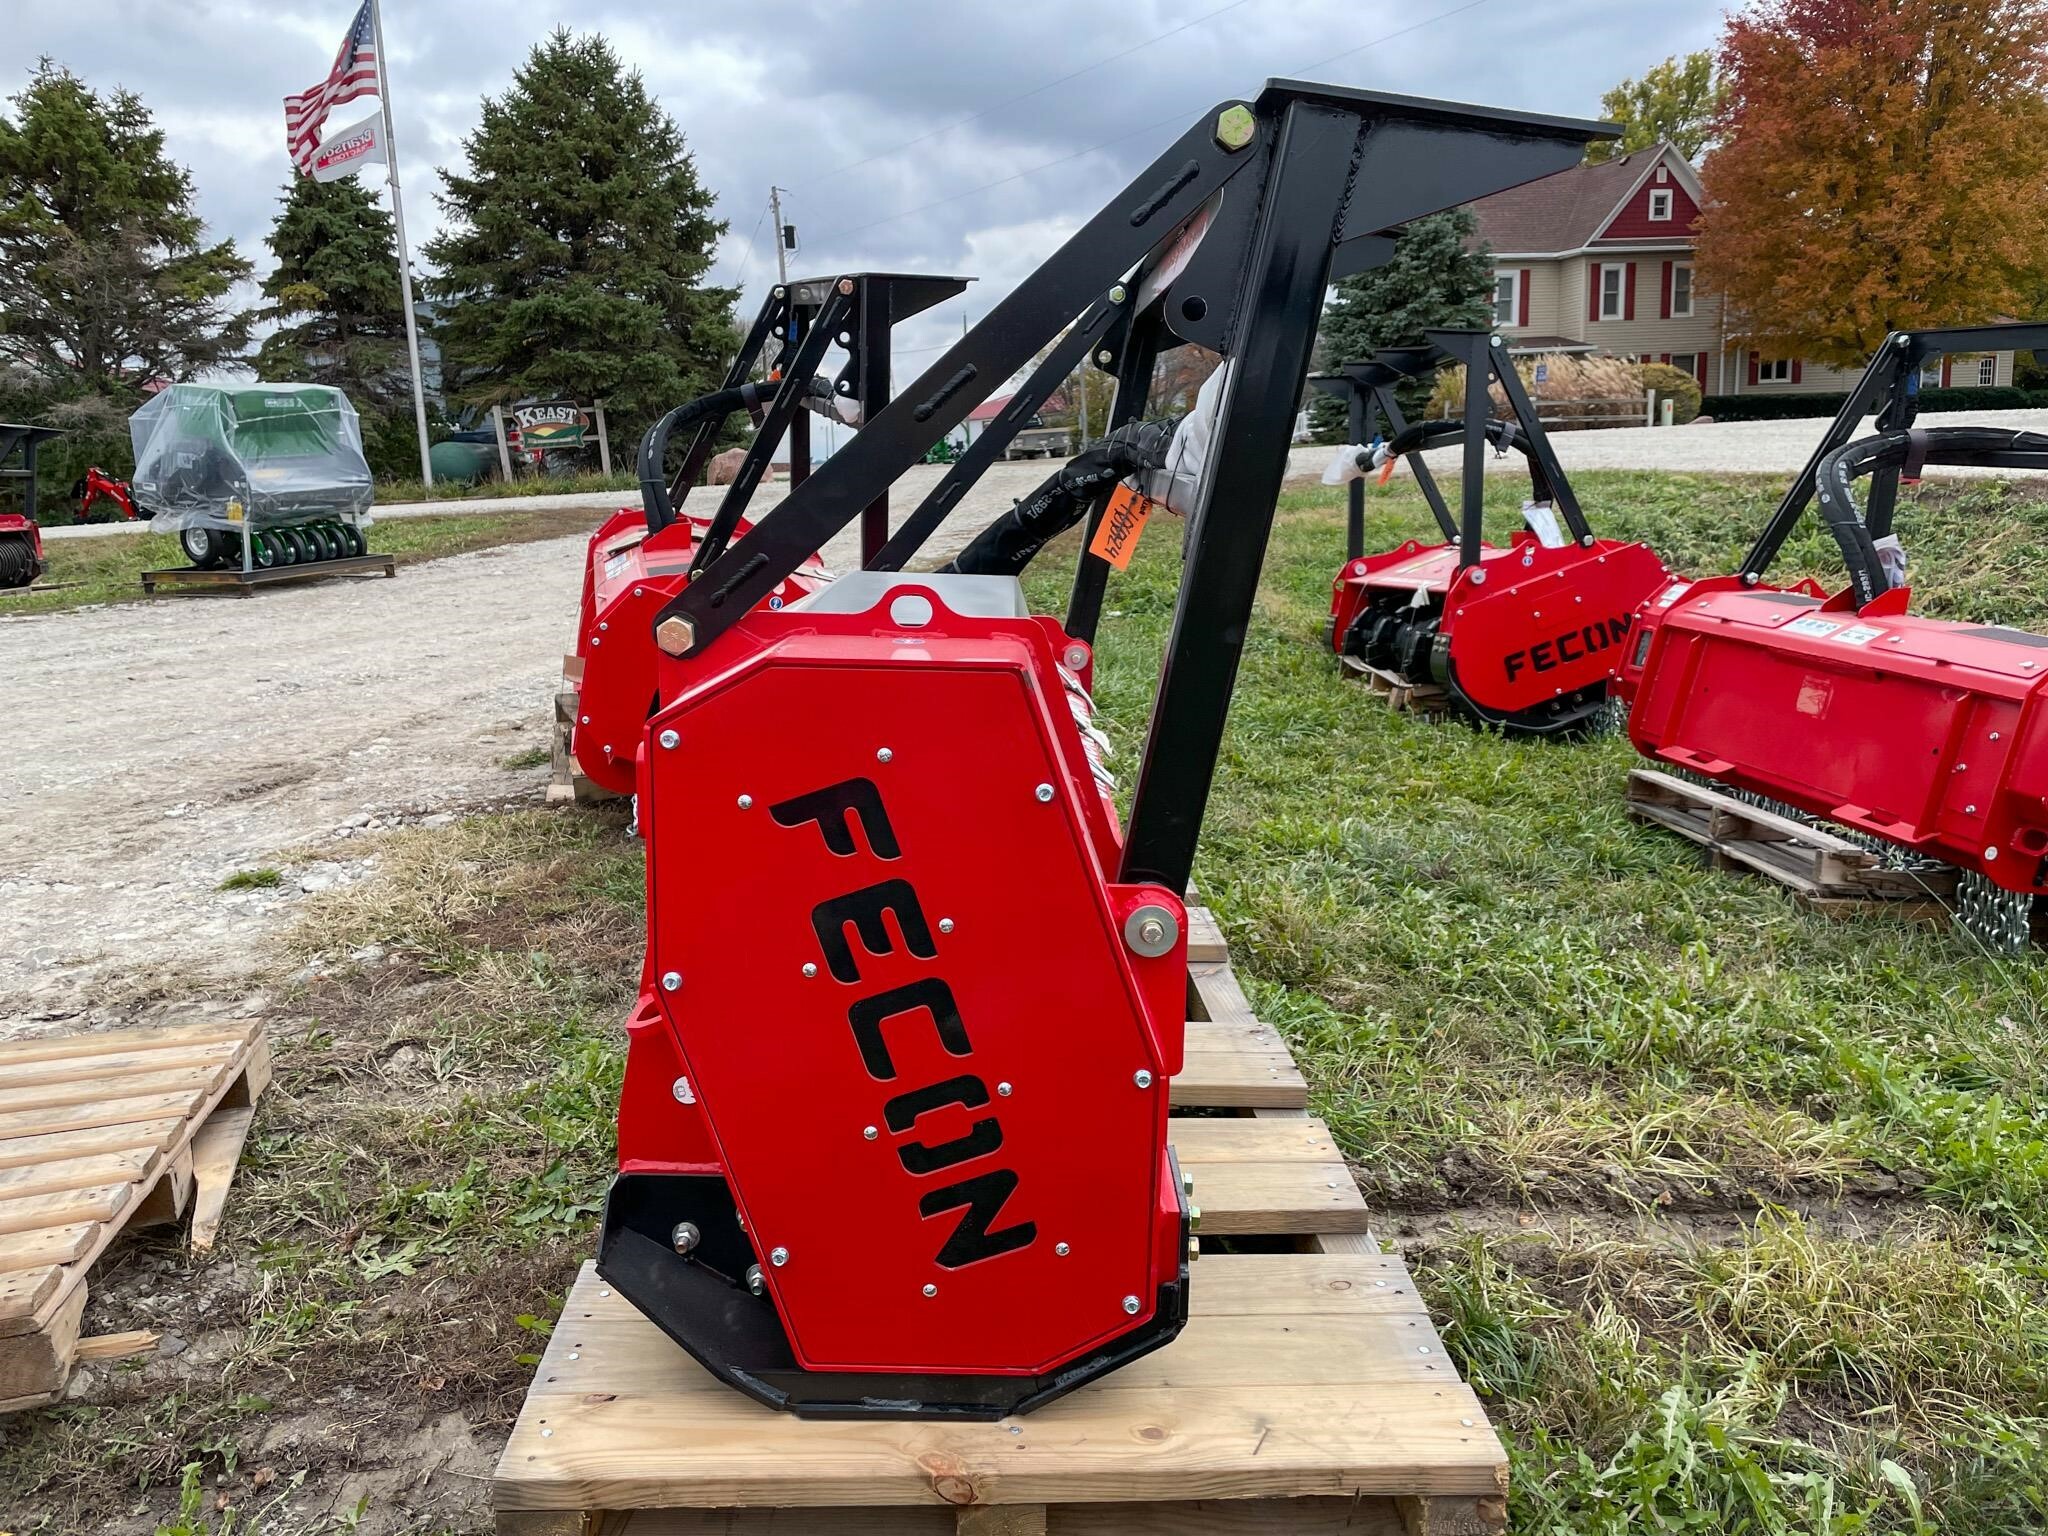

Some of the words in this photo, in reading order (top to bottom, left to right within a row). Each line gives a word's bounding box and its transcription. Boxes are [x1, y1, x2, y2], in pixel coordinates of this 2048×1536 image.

[515, 406, 577, 428] KEAST
[1503, 612, 1633, 684] FECON
[767, 776, 1038, 1272] FECON
